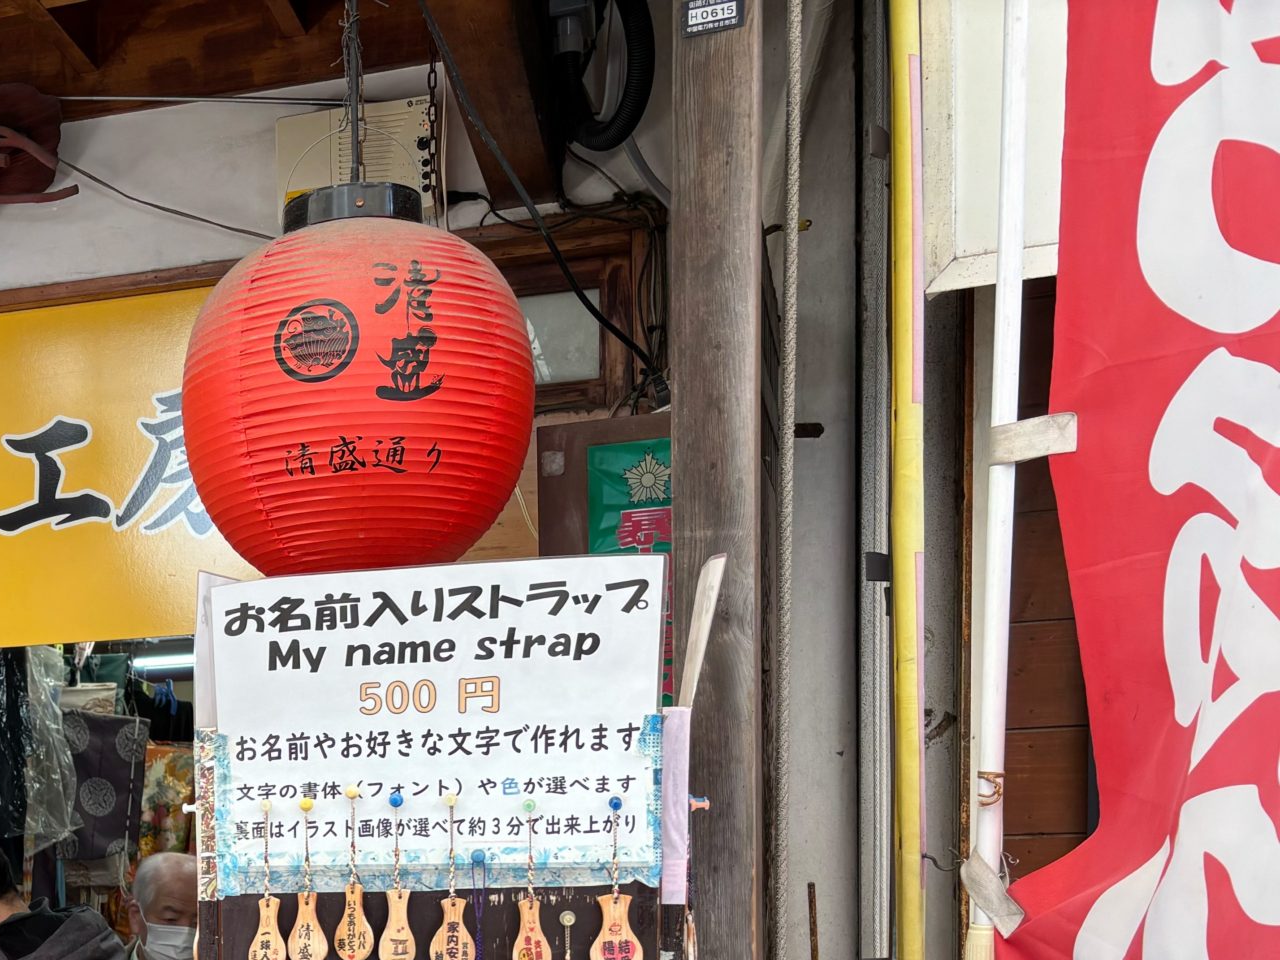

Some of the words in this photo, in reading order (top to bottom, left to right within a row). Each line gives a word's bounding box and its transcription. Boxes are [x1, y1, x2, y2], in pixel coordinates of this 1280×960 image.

[690, 5, 735, 22] H0615
[373, 259, 446, 402] 清盛
[285, 435, 443, 477] 清盛通り
[223, 577, 651, 638] お名前入りストラップ
[267, 639, 327, 674] My
[345, 633, 457, 666] name
[474, 626, 601, 661] strap
[359, 679, 438, 715] 500
[458, 676, 502, 714] 円
[234, 722, 642, 762] お名前やお好きな文字で作れます
